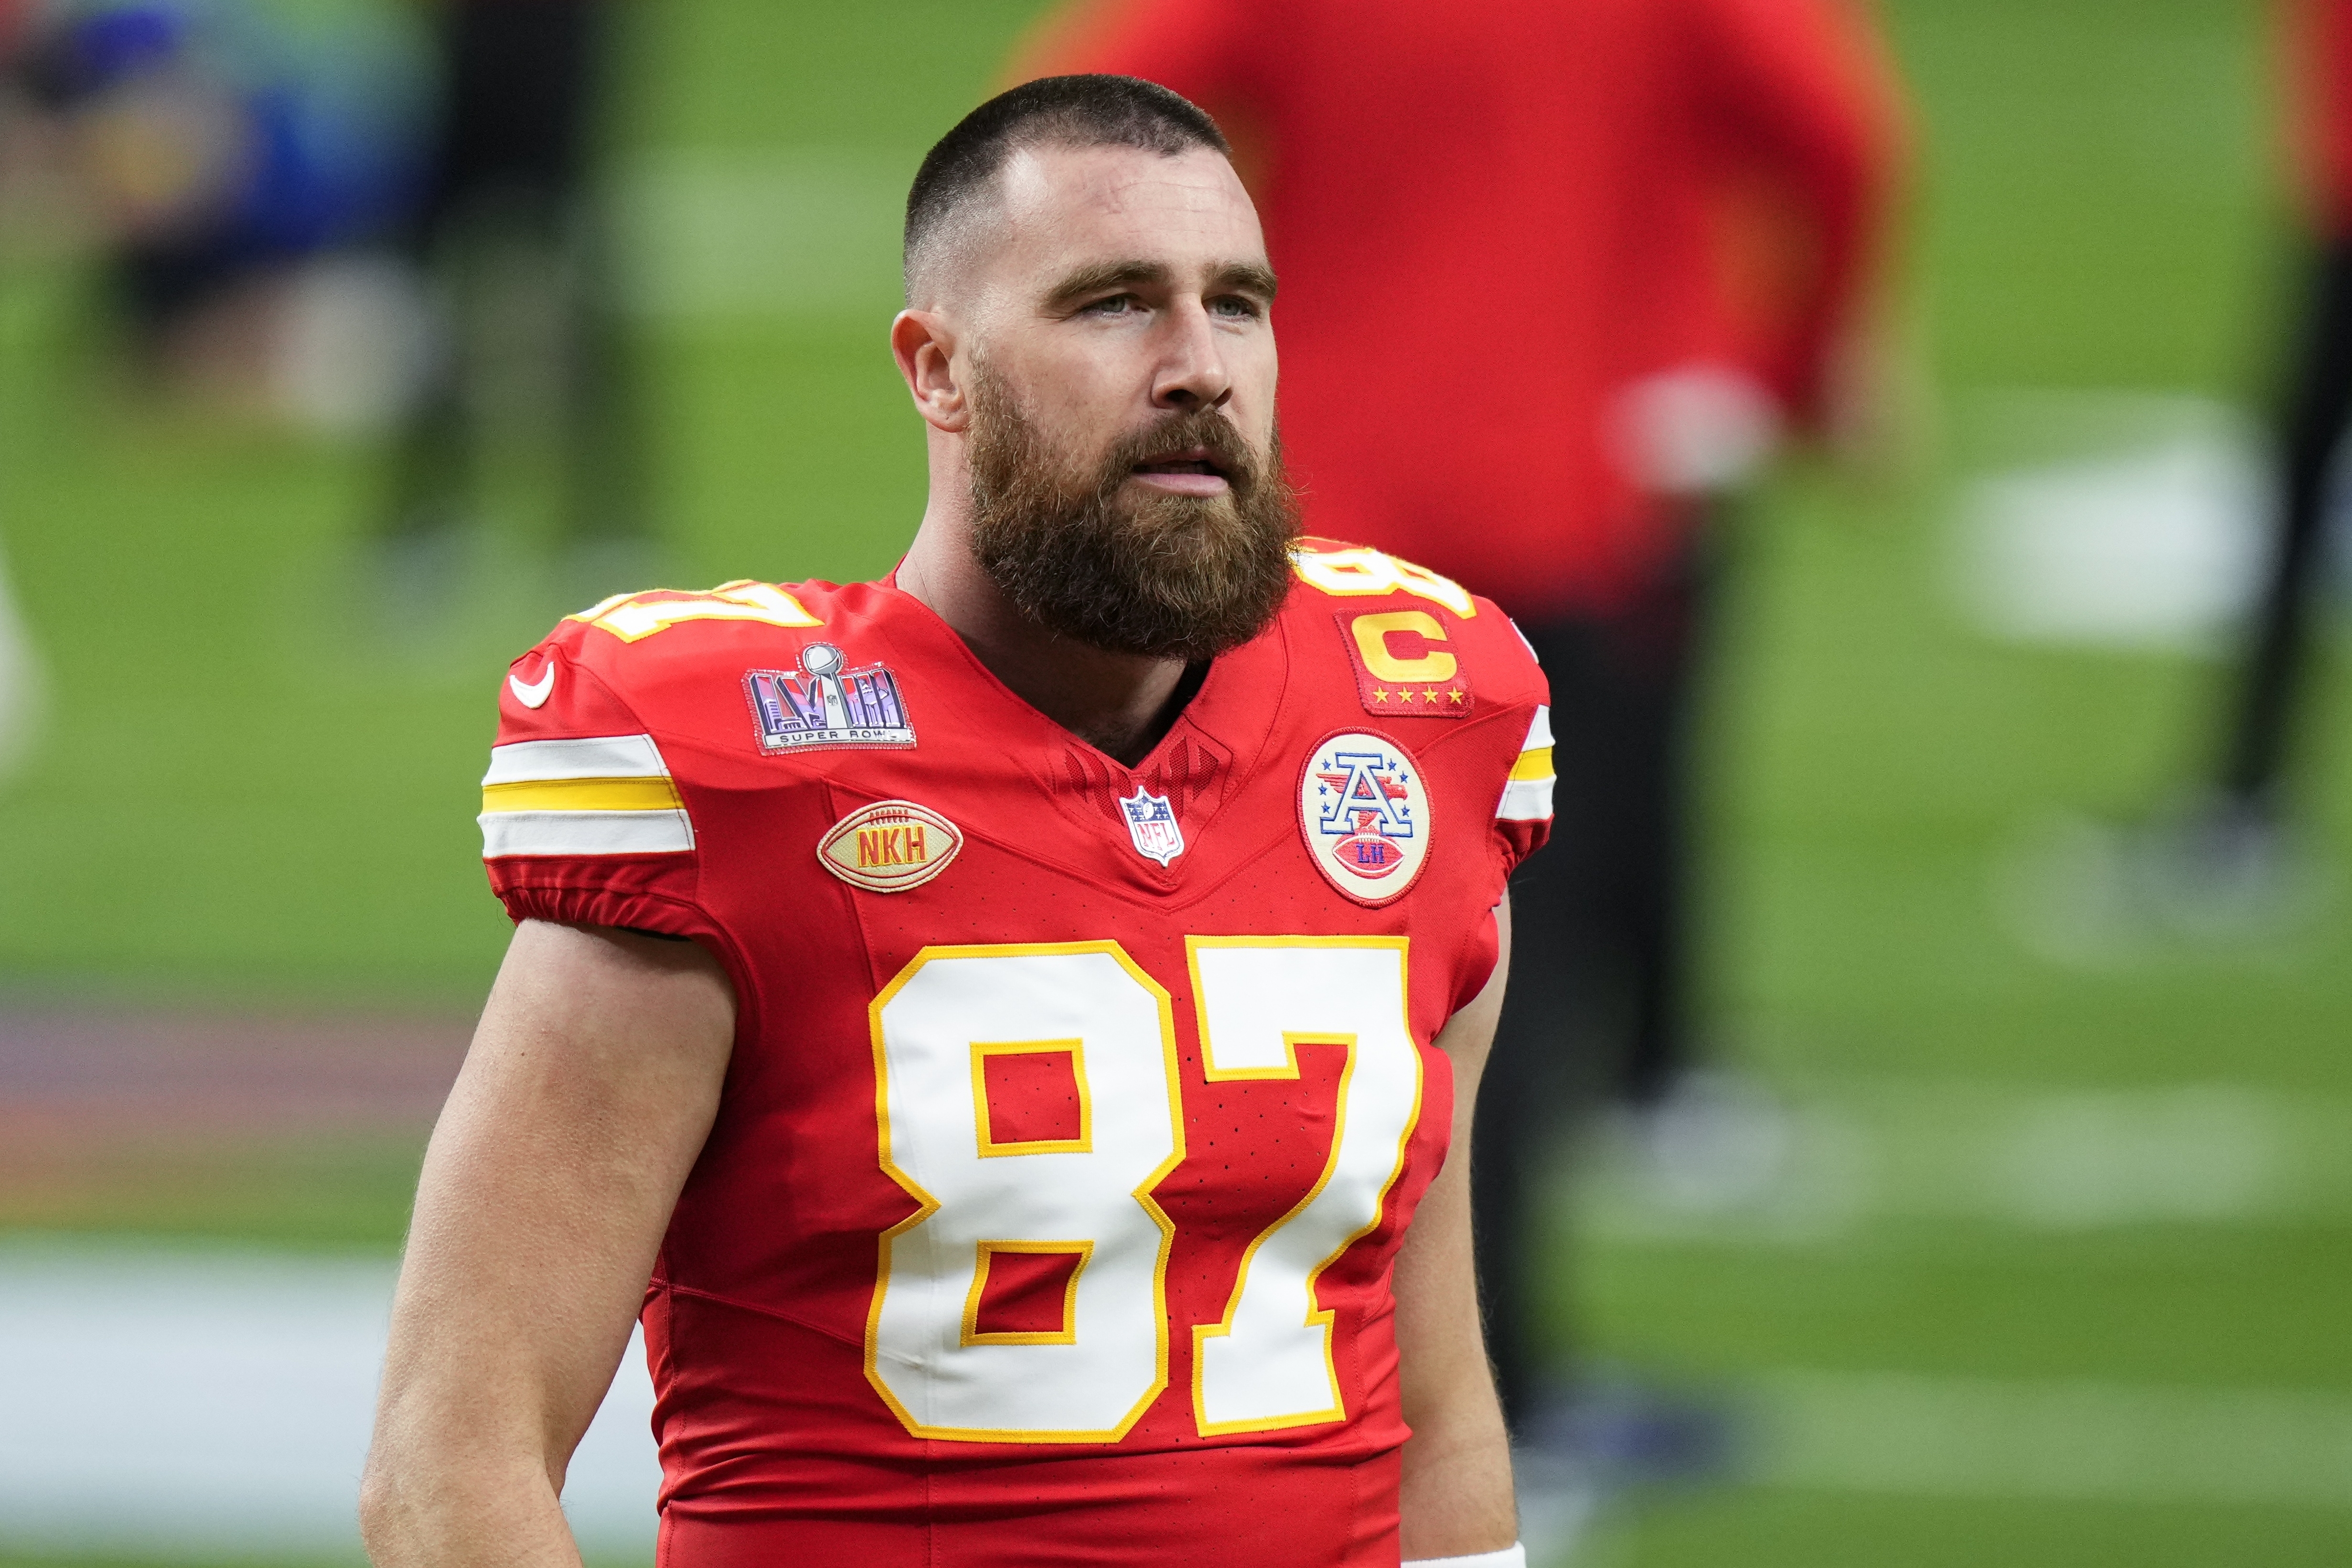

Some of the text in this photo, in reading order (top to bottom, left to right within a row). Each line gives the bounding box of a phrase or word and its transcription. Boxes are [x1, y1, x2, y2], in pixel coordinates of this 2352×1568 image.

[560, 578, 825, 644] 7
[1351, 611, 1458, 683] C
[780, 731, 838, 743] SUPER
[1320, 753, 1413, 838] A
[857, 824, 928, 868] NKH
[1137, 822, 1175, 851] NFL
[1356, 843, 1385, 864] LH
[864, 935, 1423, 1443] 87
